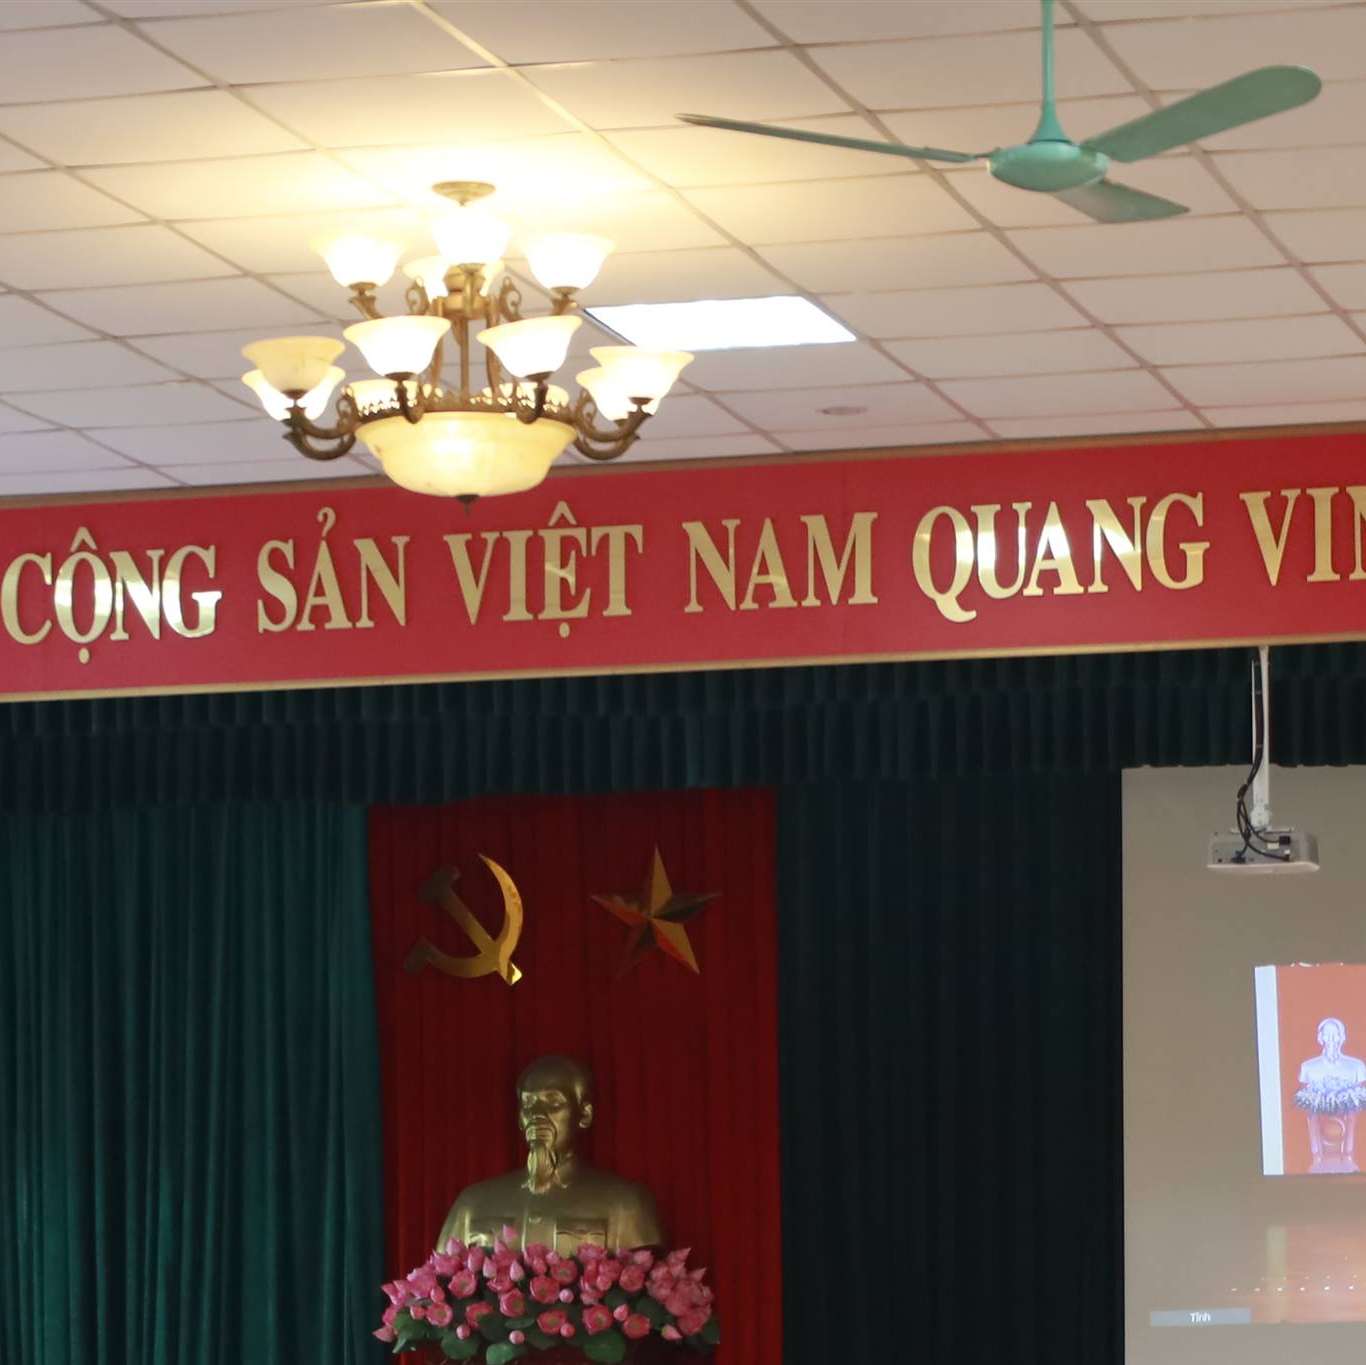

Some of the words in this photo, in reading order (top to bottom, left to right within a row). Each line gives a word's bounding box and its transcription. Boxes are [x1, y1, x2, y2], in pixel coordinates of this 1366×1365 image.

[1, 526, 222, 664] CỘNG
[256, 507, 410, 632] SẢN
[443, 501, 643, 638] VIỆT
[684, 514, 878, 613] NAM
[912, 492, 1210, 623] QUANG
